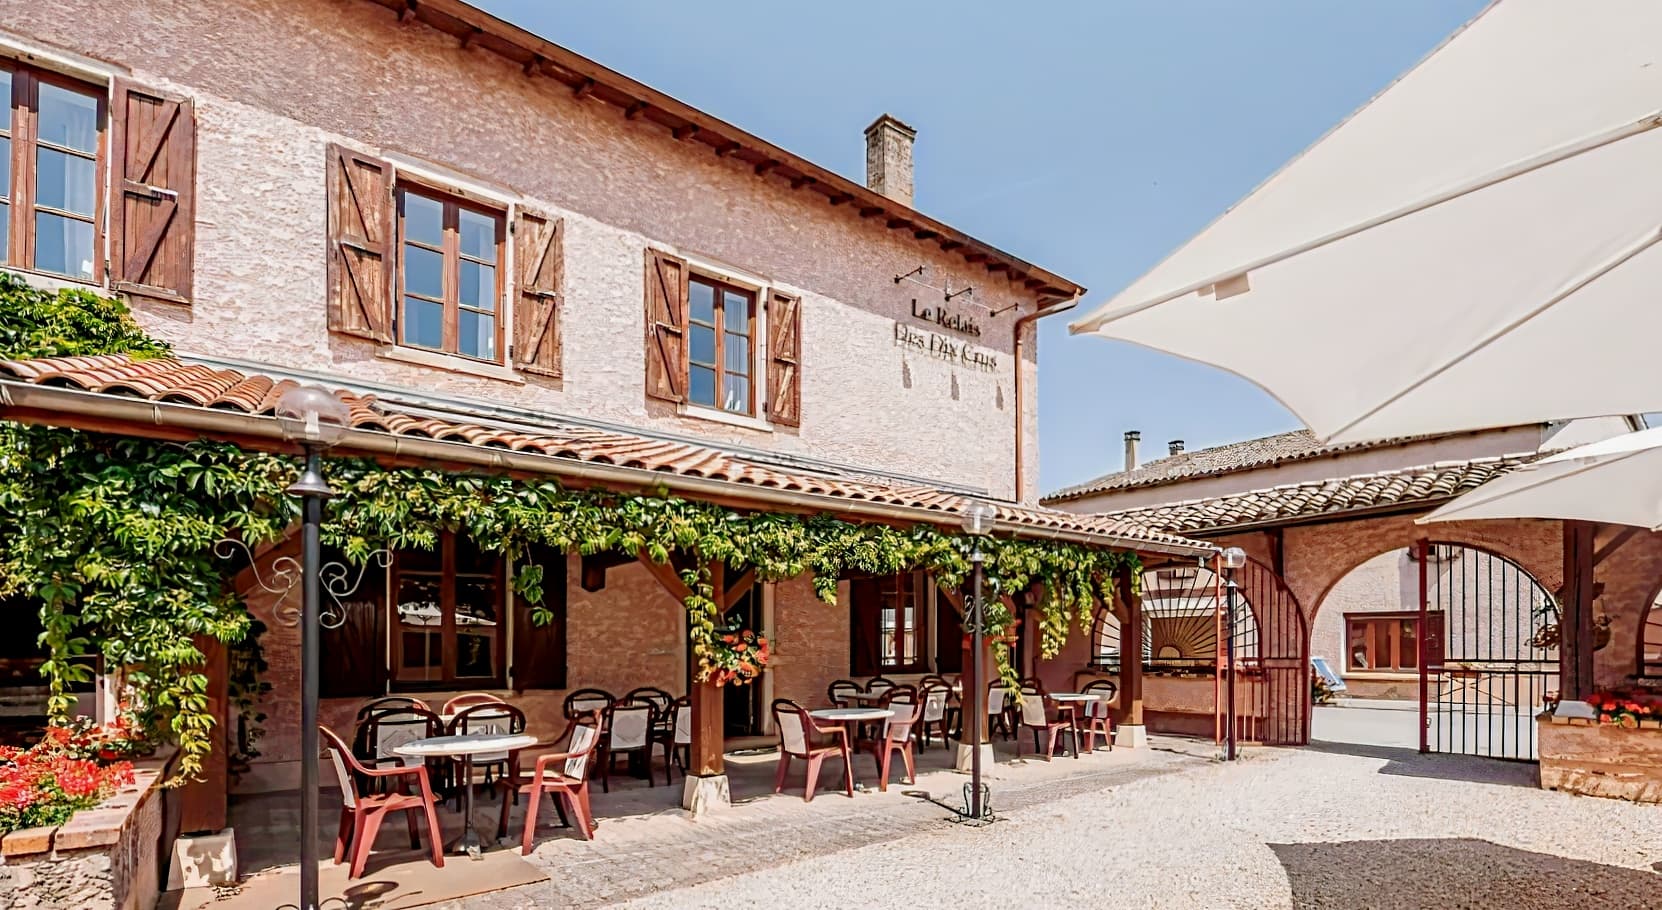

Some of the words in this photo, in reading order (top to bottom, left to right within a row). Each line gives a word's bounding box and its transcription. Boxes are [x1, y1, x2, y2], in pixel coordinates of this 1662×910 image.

[911, 299, 931, 321] Le
[936, 307, 981, 337] Relais
[895, 322, 925, 348] Des
[930, 333, 957, 357] Dix
[962, 343, 997, 367] Crus
